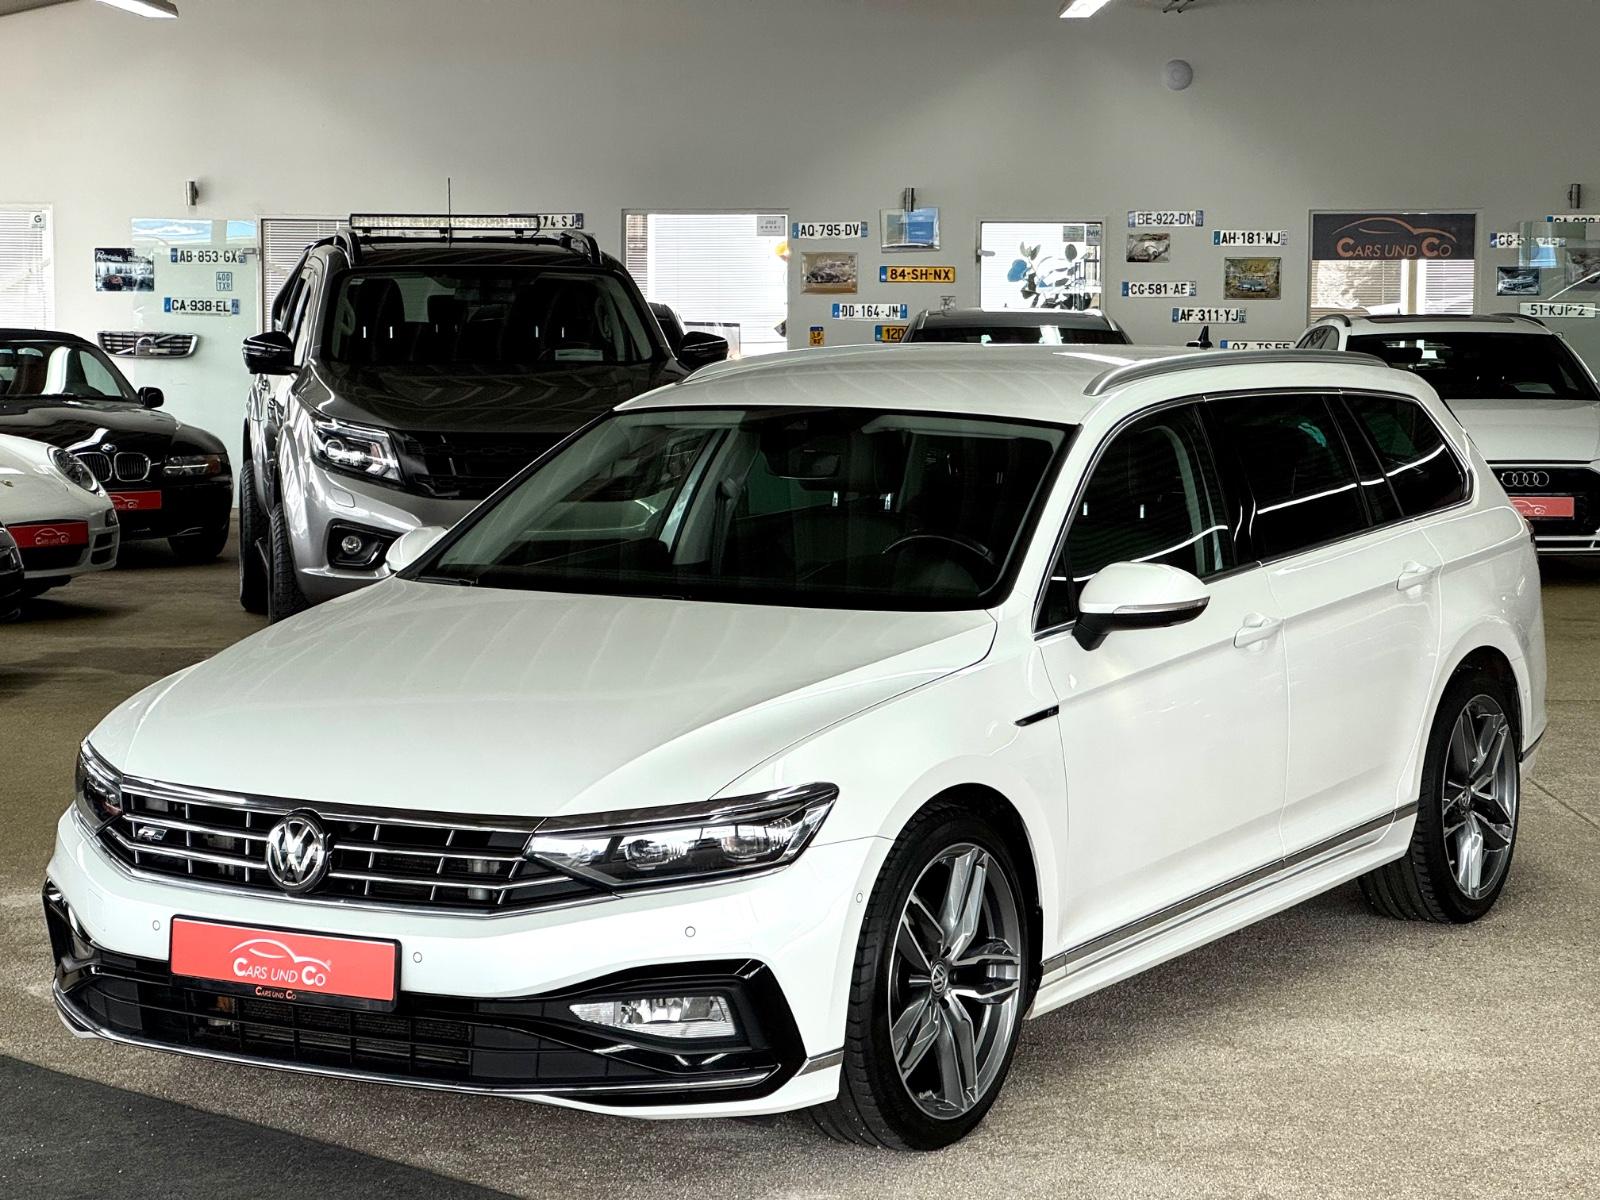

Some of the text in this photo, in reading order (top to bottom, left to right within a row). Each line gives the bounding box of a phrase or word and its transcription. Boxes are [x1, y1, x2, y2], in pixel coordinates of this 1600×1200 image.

[539, 215, 575, 228] 74-SJ
[800, 224, 860, 237] AQ-795-DV
[1220, 231, 1281, 244] AH-181-WJ
[179, 250, 238, 263] AB-853-GX
[889, 268, 951, 281] 84-SH-NX
[1130, 283, 1188, 295] CG-581-AE
[171, 300, 231, 312] CA-938-EL
[1180, 309, 1239, 321] AF-311-YJ
